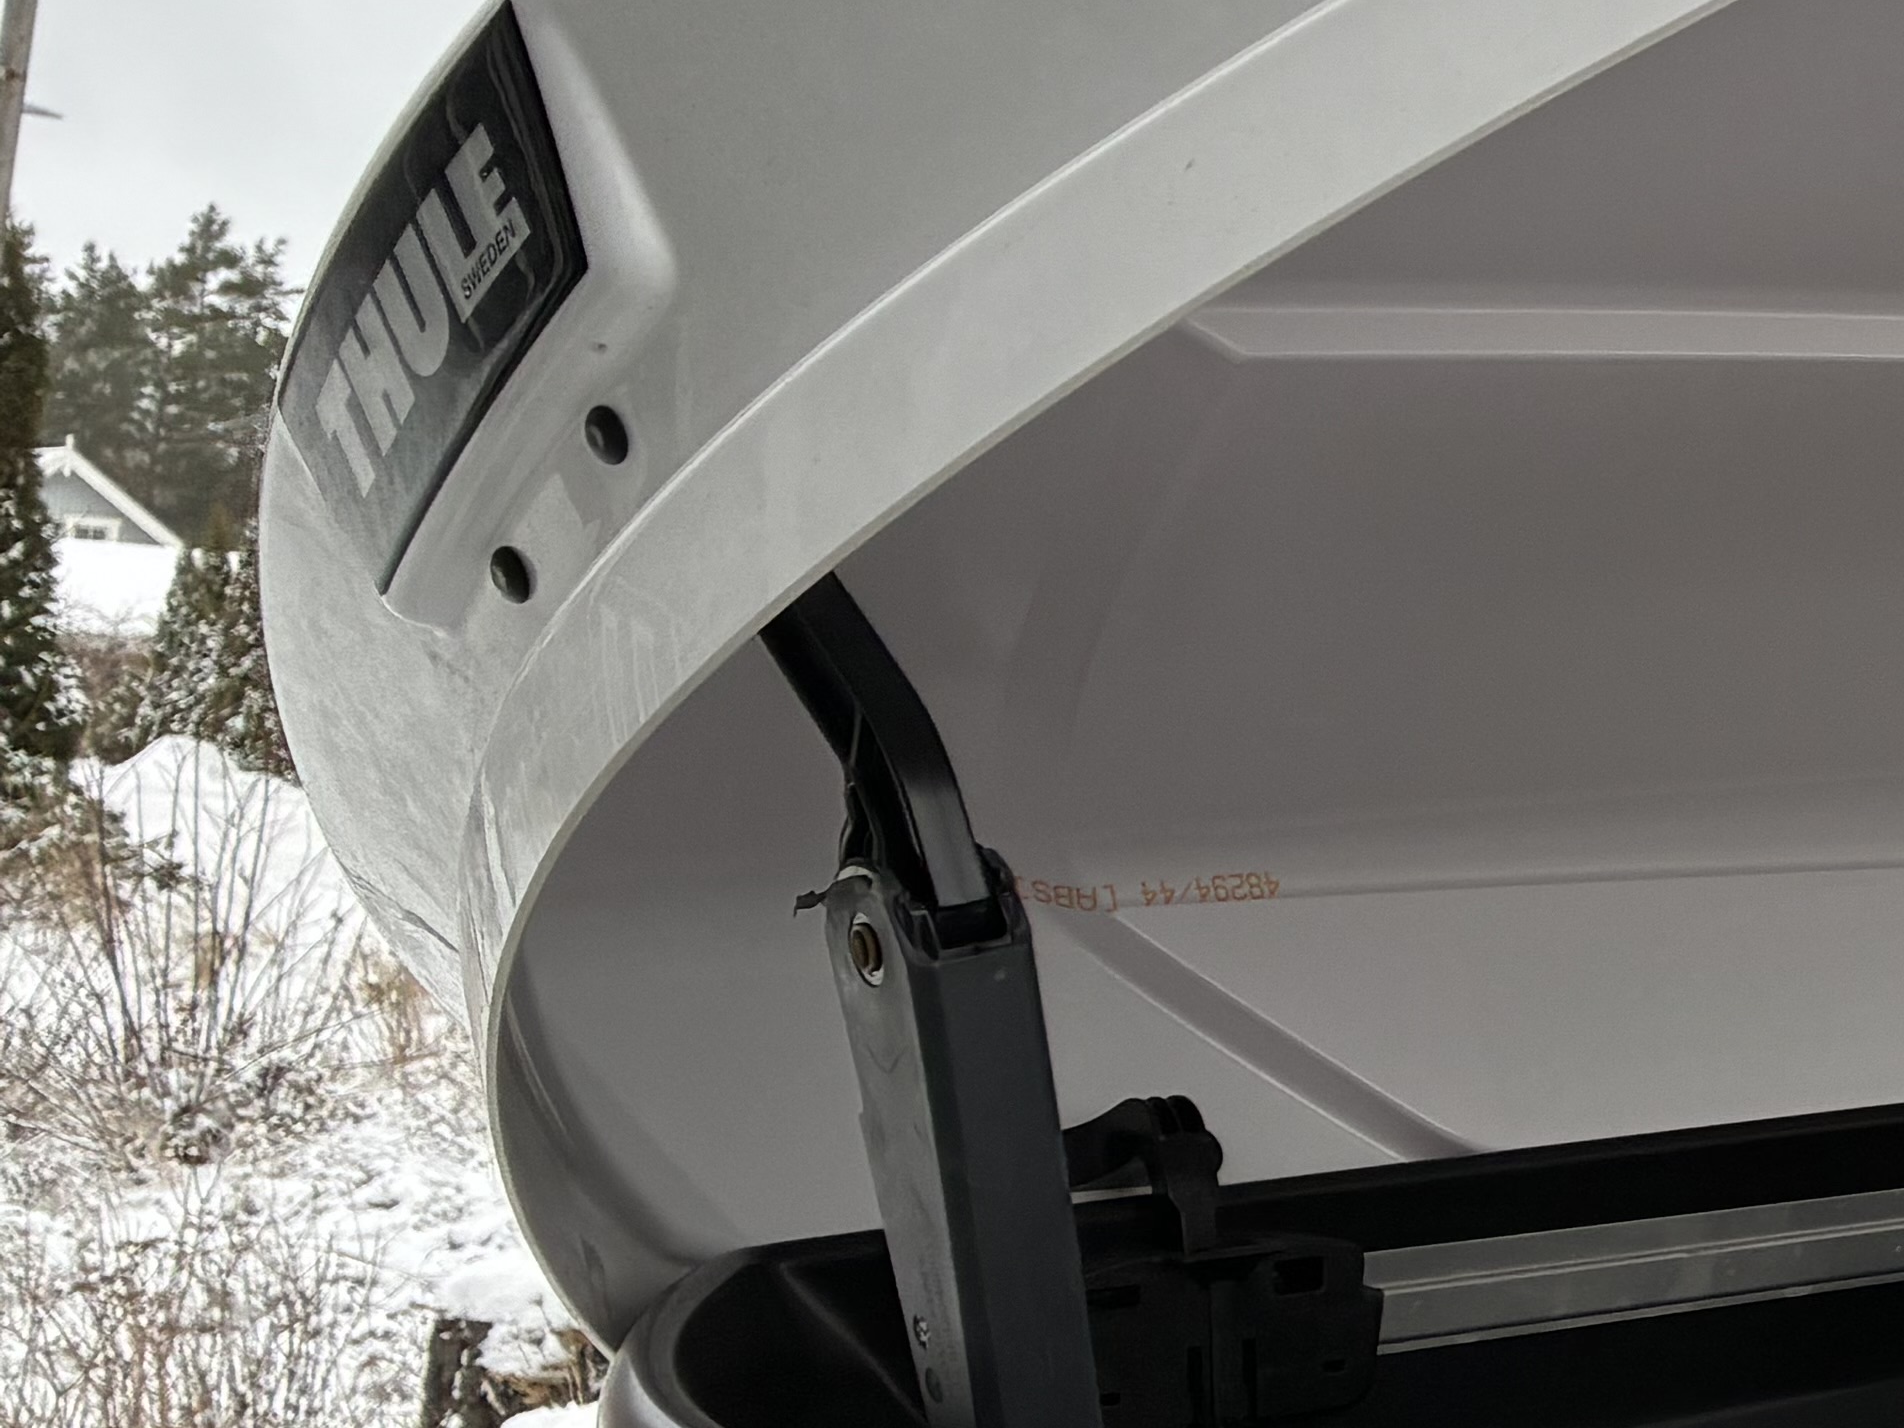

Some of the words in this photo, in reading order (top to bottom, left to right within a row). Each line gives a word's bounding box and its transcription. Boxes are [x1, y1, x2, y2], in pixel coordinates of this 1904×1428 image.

[459, 218, 517, 301] SWEDEN
[314, 123, 531, 498] THULE
[1141, 871, 1281, 907] 48294/44
